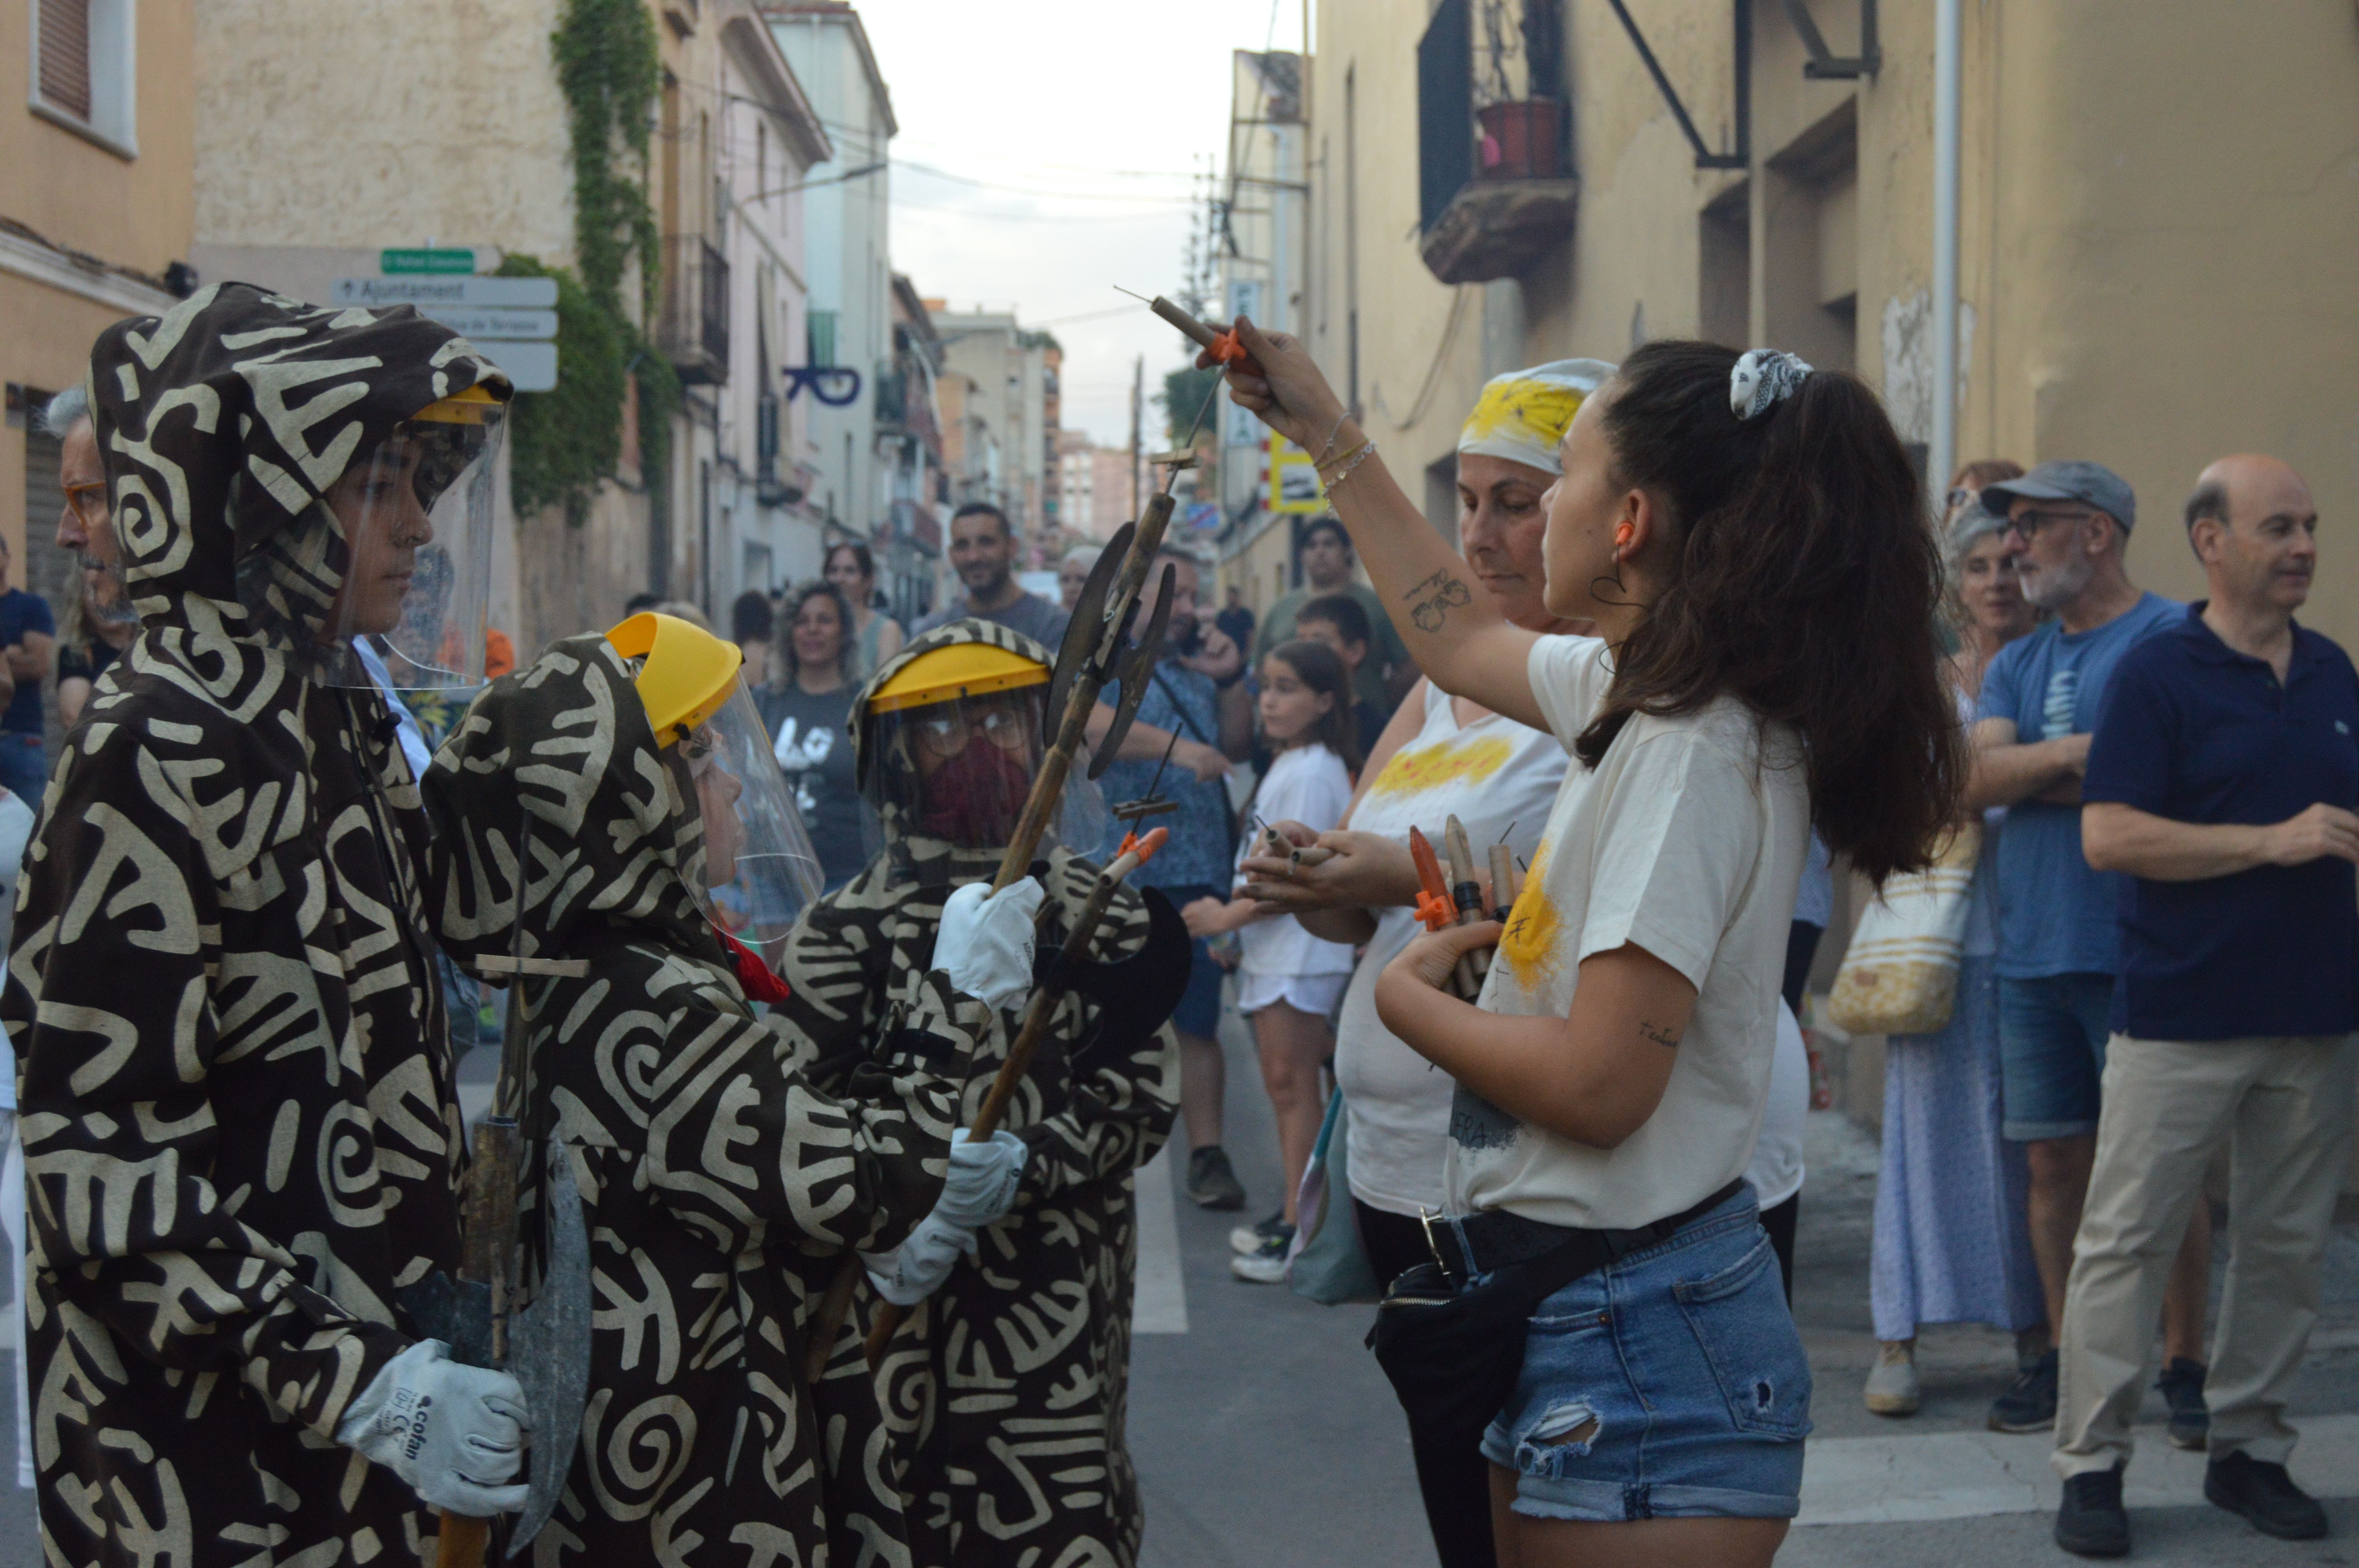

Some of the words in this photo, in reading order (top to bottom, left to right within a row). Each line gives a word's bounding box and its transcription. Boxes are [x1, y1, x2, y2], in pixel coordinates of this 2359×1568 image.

[360, 281, 464, 303] Ajuntament
[1452, 1112, 1487, 1148] ERA
[405, 1412, 428, 1461] cofan
